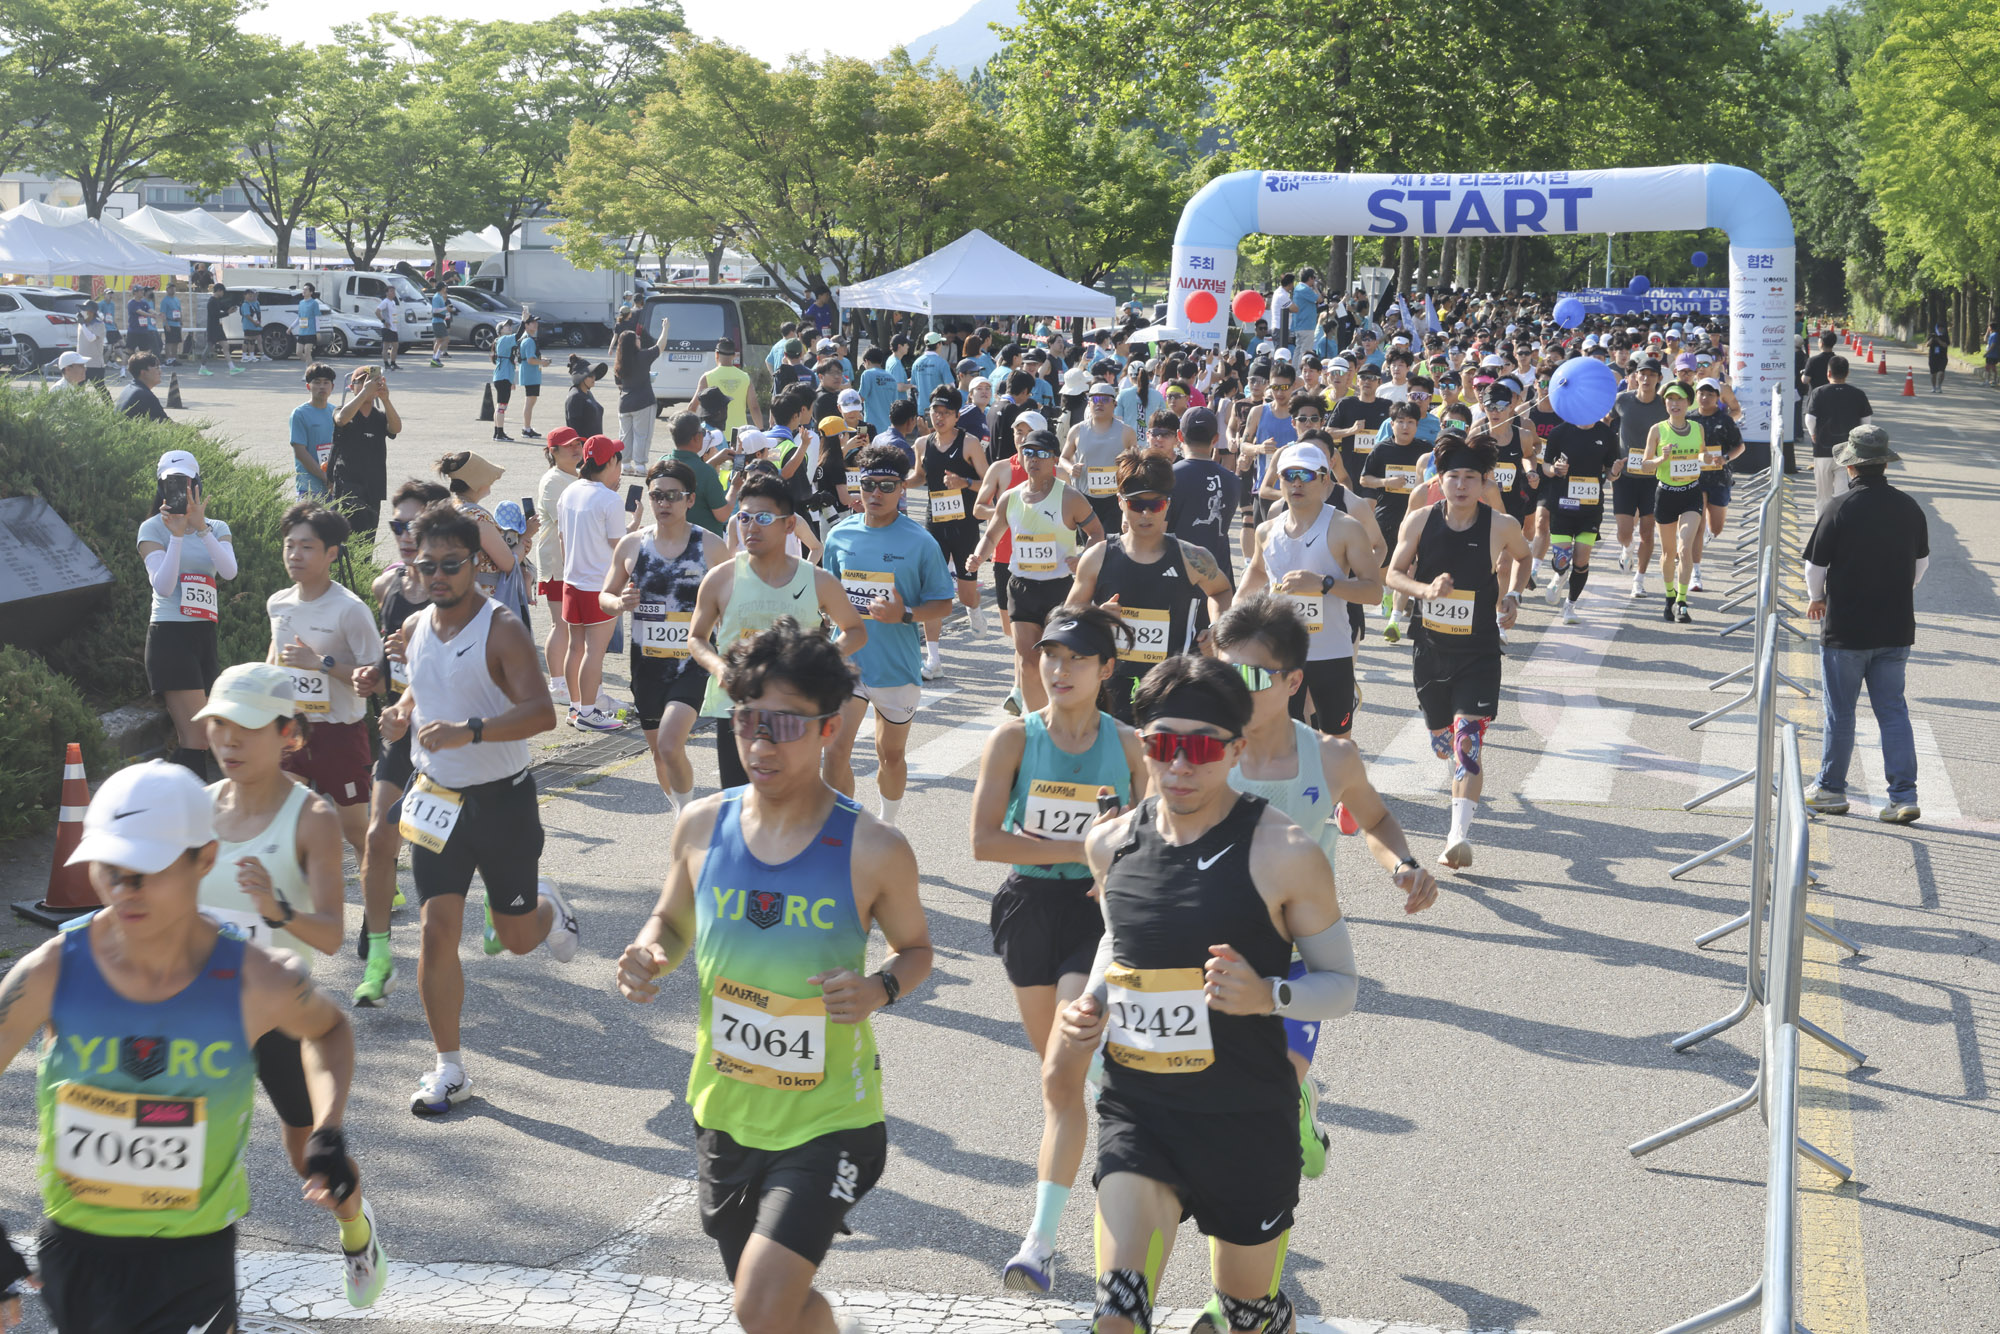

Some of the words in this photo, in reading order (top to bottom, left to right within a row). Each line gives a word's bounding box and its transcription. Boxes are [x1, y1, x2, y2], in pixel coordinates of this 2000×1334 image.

[1392, 174, 1451, 187] 제1회
[1367, 187, 1593, 234] START
[1189, 256, 1214, 270] 주최
[1747, 254, 1774, 269] 협찬
[1176, 276, 1226, 294] 시사저널
[1650, 298, 1702, 312] 10km
[1709, 298, 1723, 312] B
[1673, 463, 1698, 473] 1322
[1090, 475, 1117, 486] 1124
[1572, 486, 1598, 495] 1243
[934, 499, 961, 512] 1319
[1020, 546, 1053, 559] 1159
[186, 587, 213, 604] 553
[638, 604, 660, 613] 0238
[1426, 601, 1470, 619] 1249
[647, 627, 690, 642] 1202
[712, 886, 746, 921] YJ
[784, 894, 837, 930] RC
[720, 982, 769, 1009] 시사저널
[1115, 1001, 1198, 1038] 1242
[720, 1012, 815, 1060] 7064
[67, 1034, 121, 1075] YJ
[168, 1038, 233, 1079] RC
[1166, 1057, 1182, 1067] 10
[1185, 1056, 1207, 1066] km
[776, 1075, 793, 1087] 10
[794, 1075, 817, 1087] km
[65, 1124, 189, 1171] 7063
